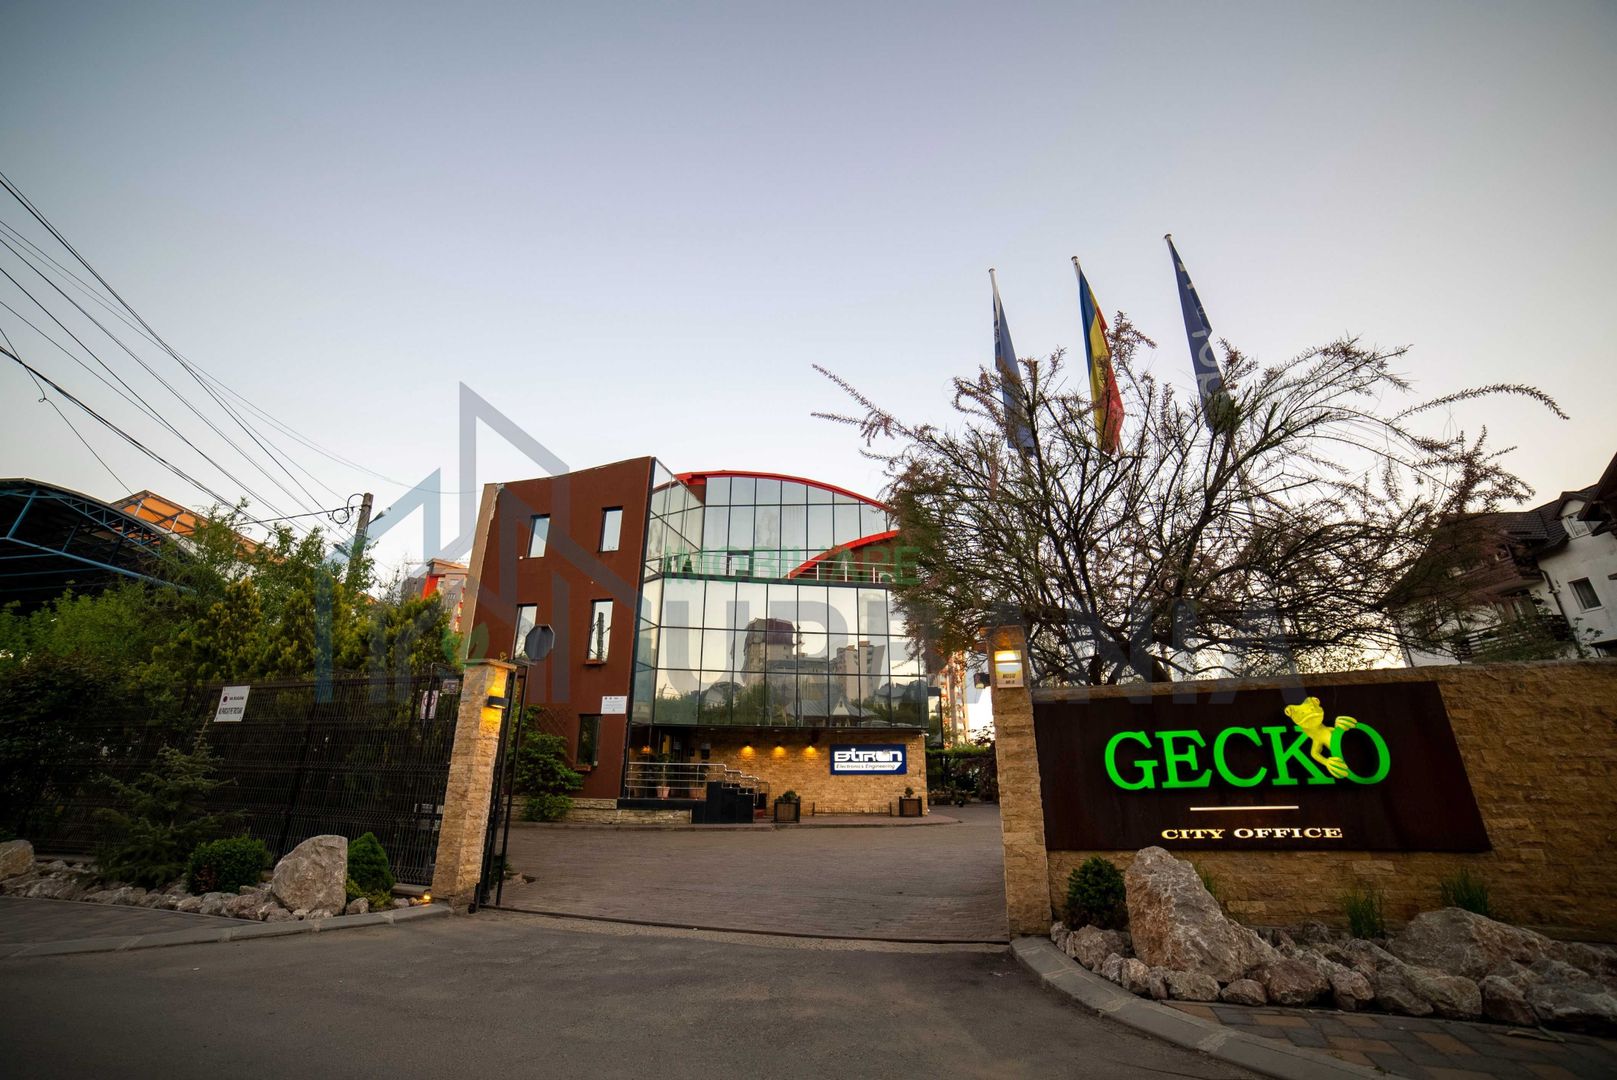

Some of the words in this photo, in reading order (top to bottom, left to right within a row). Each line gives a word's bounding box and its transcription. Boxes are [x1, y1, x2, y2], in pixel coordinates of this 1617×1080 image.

[1103, 721, 1391, 791] GECKO
[1161, 828, 1226, 840] CITY
[1233, 827, 1343, 839] OFFICE
